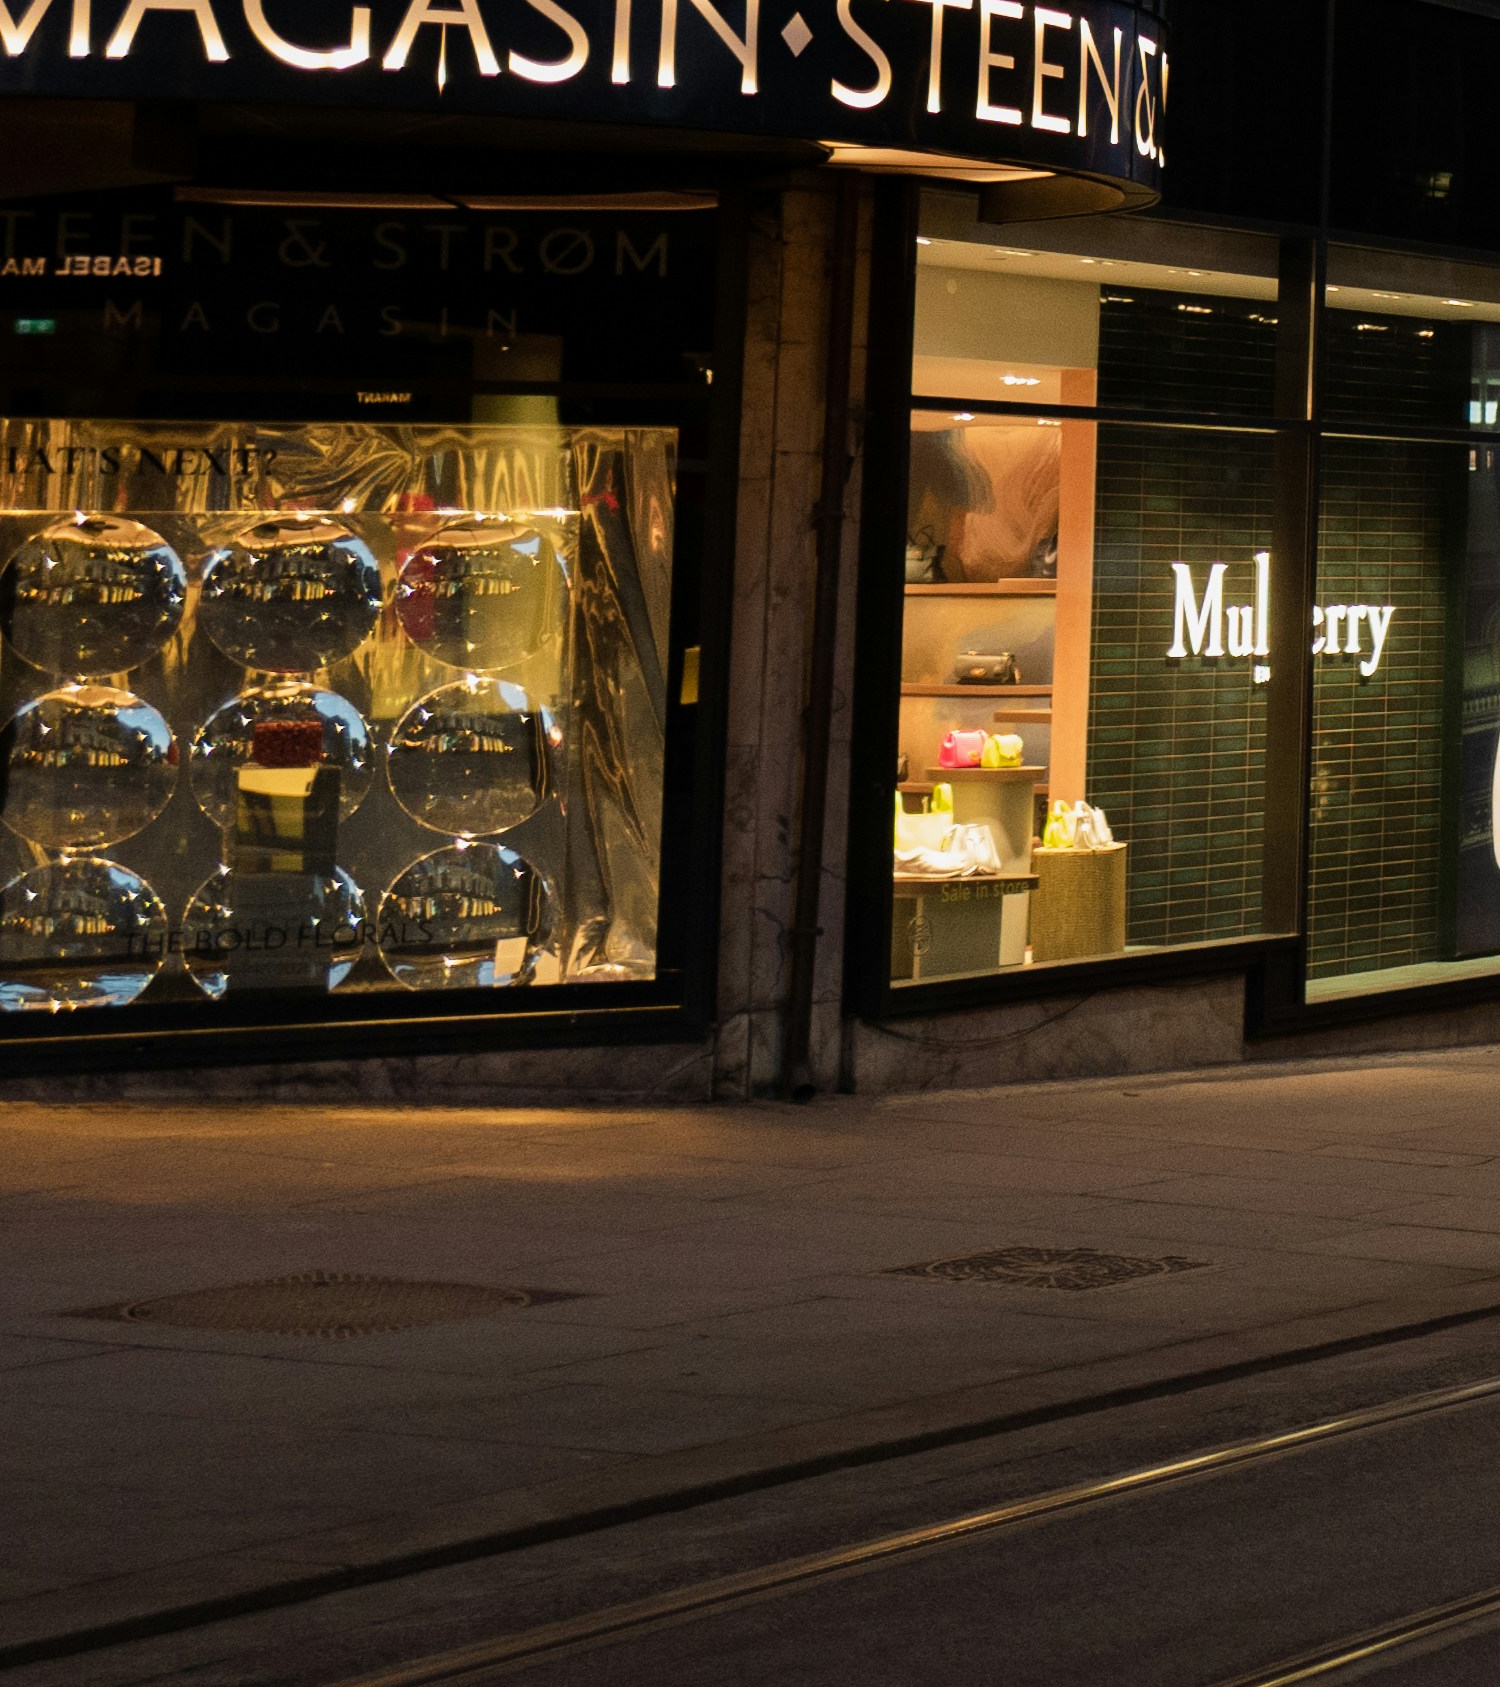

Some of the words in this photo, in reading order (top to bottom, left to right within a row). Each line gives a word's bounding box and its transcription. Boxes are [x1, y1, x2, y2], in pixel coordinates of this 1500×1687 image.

[1135, 34, 1157, 160] &
[278, 220, 333, 268] &
[373, 222, 668, 279] STRØM
[104, 297, 519, 339] MAGASIN
[138, 446, 278, 476] NEXT?
[1166, 551, 1396, 677] Mulerry
[941, 881, 970, 903] Sale
[976, 881, 988, 900] in
[992, 880, 1029, 897] store
[124, 930, 184, 955] THE
[196, 928, 287, 952] BOLD
[299, 920, 433, 948] FLORALS
